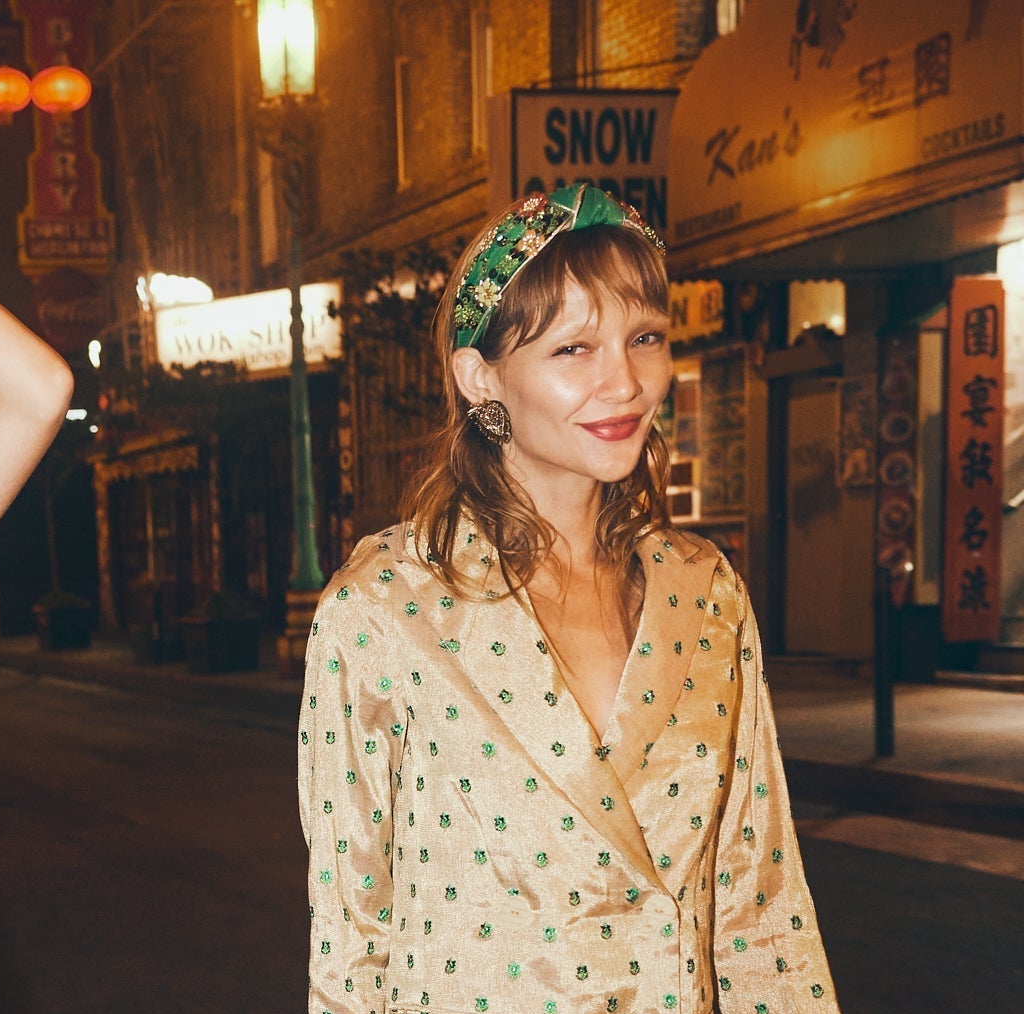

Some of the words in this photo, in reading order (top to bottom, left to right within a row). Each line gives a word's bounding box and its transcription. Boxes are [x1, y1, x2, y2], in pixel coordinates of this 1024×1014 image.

[544, 106, 657, 165] SNOW
[704, 105, 801, 187] Kan's
[174, 328, 234, 356] WOK
[249, 313, 326, 348] SHP
